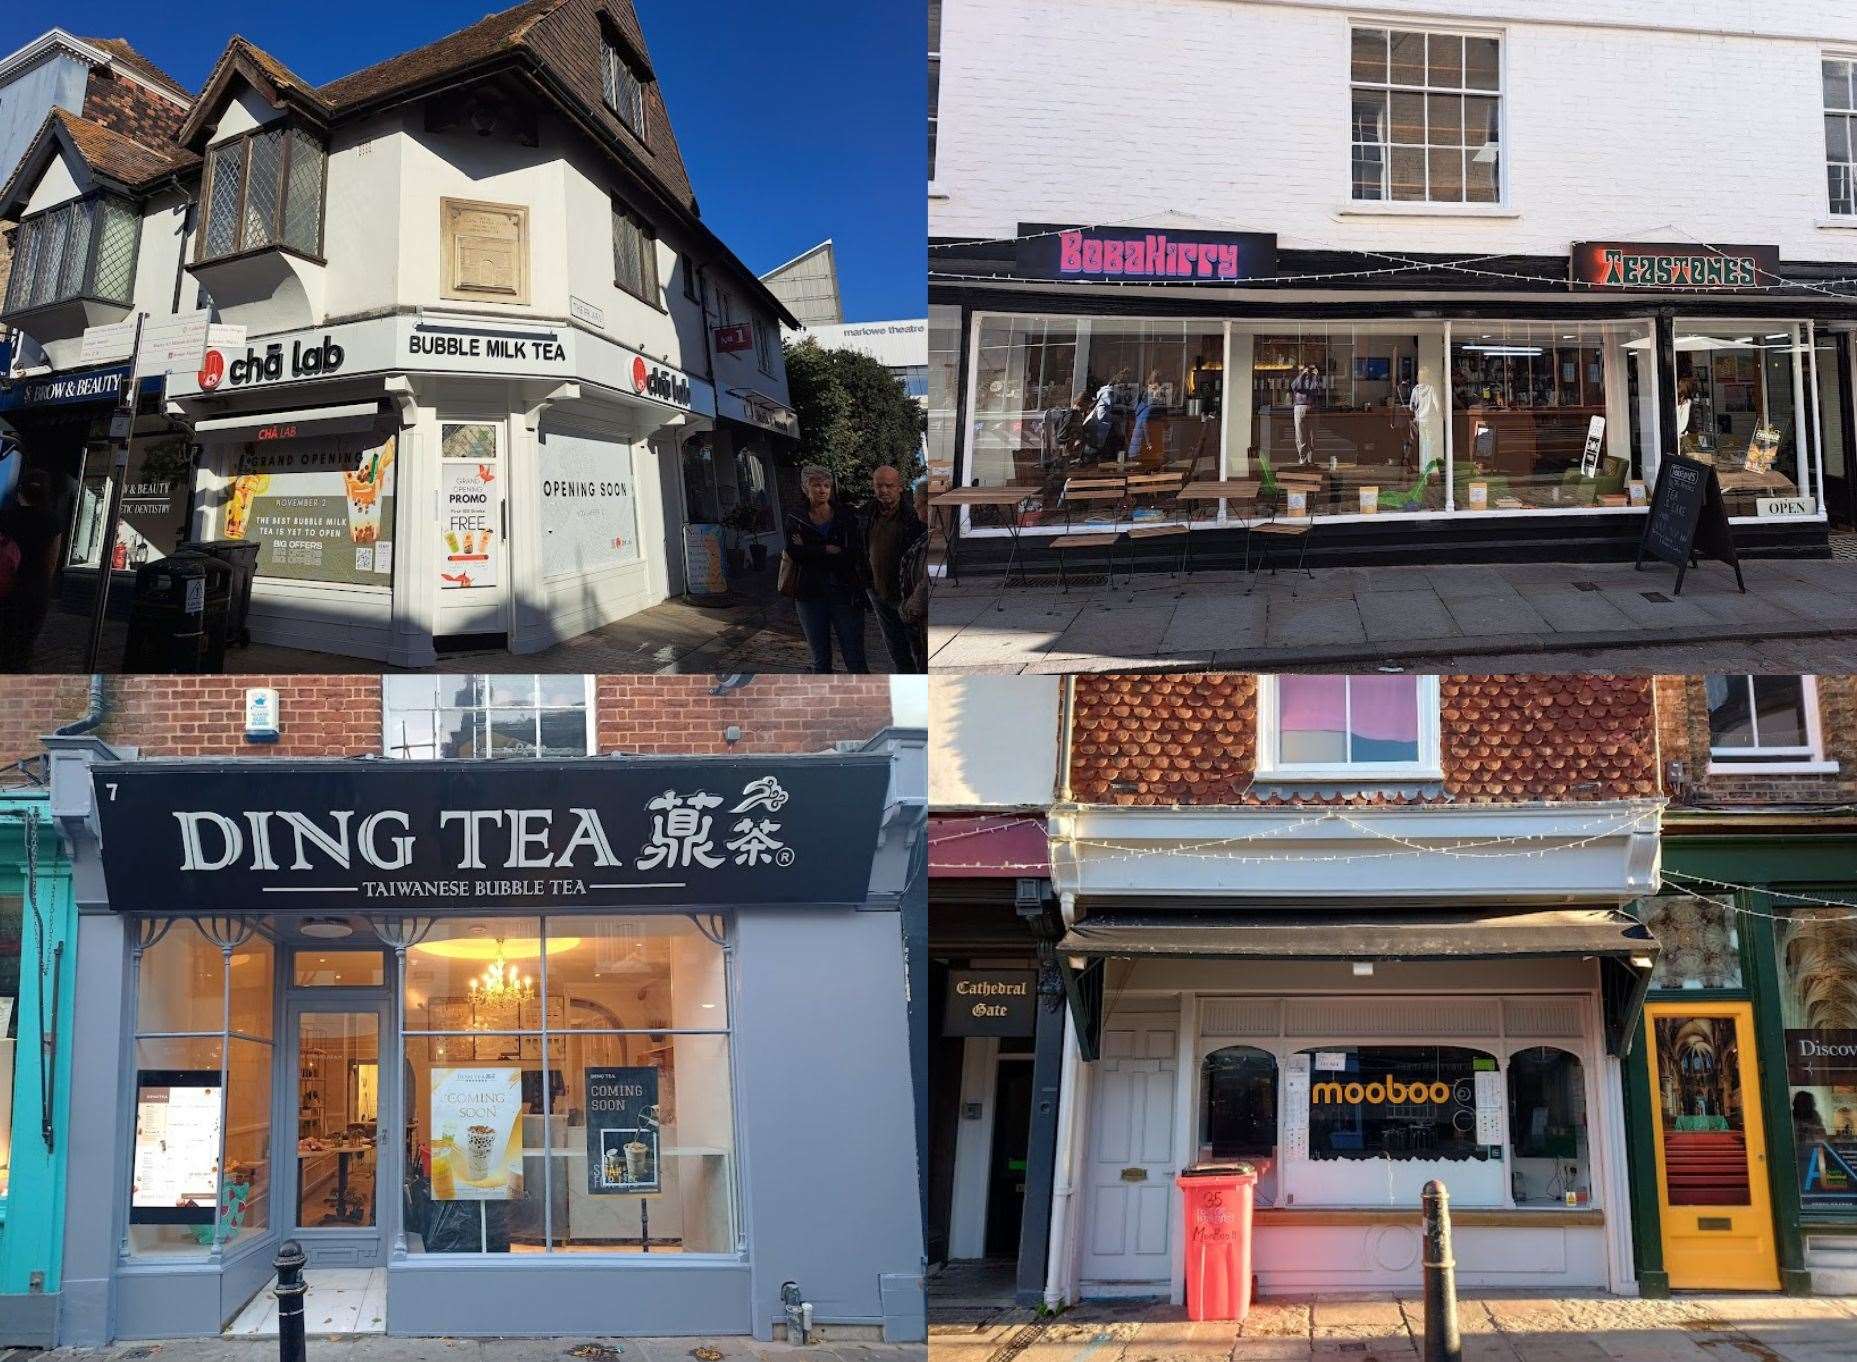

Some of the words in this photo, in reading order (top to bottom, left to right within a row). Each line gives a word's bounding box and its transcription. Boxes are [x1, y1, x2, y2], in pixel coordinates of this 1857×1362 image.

[409, 335, 480, 357] BUBBLE
[486, 339, 526, 360] MILK
[531, 342, 566, 362] TEA
[291, 335, 345, 378] lab
[65, 380, 75, 398] &
[77, 373, 122, 396] BEAUTY
[252, 455, 294, 467] GRAND
[301, 452, 363, 466] OPENING
[543, 480, 596, 497] OPENING
[600, 482, 628, 497] SOON
[276, 498, 319, 507] NOVEMBER
[449, 494, 488, 504] PROMO
[1769, 501, 1806, 515] OPEN
[256, 516, 269, 525] THE
[272, 516, 291, 525] BEST
[294, 517, 323, 526] BUBBLE
[326, 517, 347, 526] MILK
[450, 515, 487, 531] FREE
[260, 527, 273, 536] TEA
[276, 527, 285, 536] IS
[287, 528, 301, 536] YET
[305, 528, 316, 537] TO
[320, 529, 341, 538] OPEN
[273, 539, 288, 548] BIG
[289, 540, 323, 550] OFFERS
[106, 783, 118, 801] 7
[172, 810, 416, 871] DING
[440, 807, 623, 870] TEA
[363, 880, 469, 898] TAIWANESE
[475, 880, 545, 896] BUBBLE
[549, 880, 587, 895] TEA
[956, 981, 1027, 996] Cathedral
[972, 1003, 1008, 1017] Gate
[591, 1085, 643, 1097] COMING
[1312, 1074, 1450, 1105] mooboo
[447, 1093, 505, 1104] COMING
[591, 1099, 626, 1111] SOON
[459, 1106, 496, 1118] SOON
